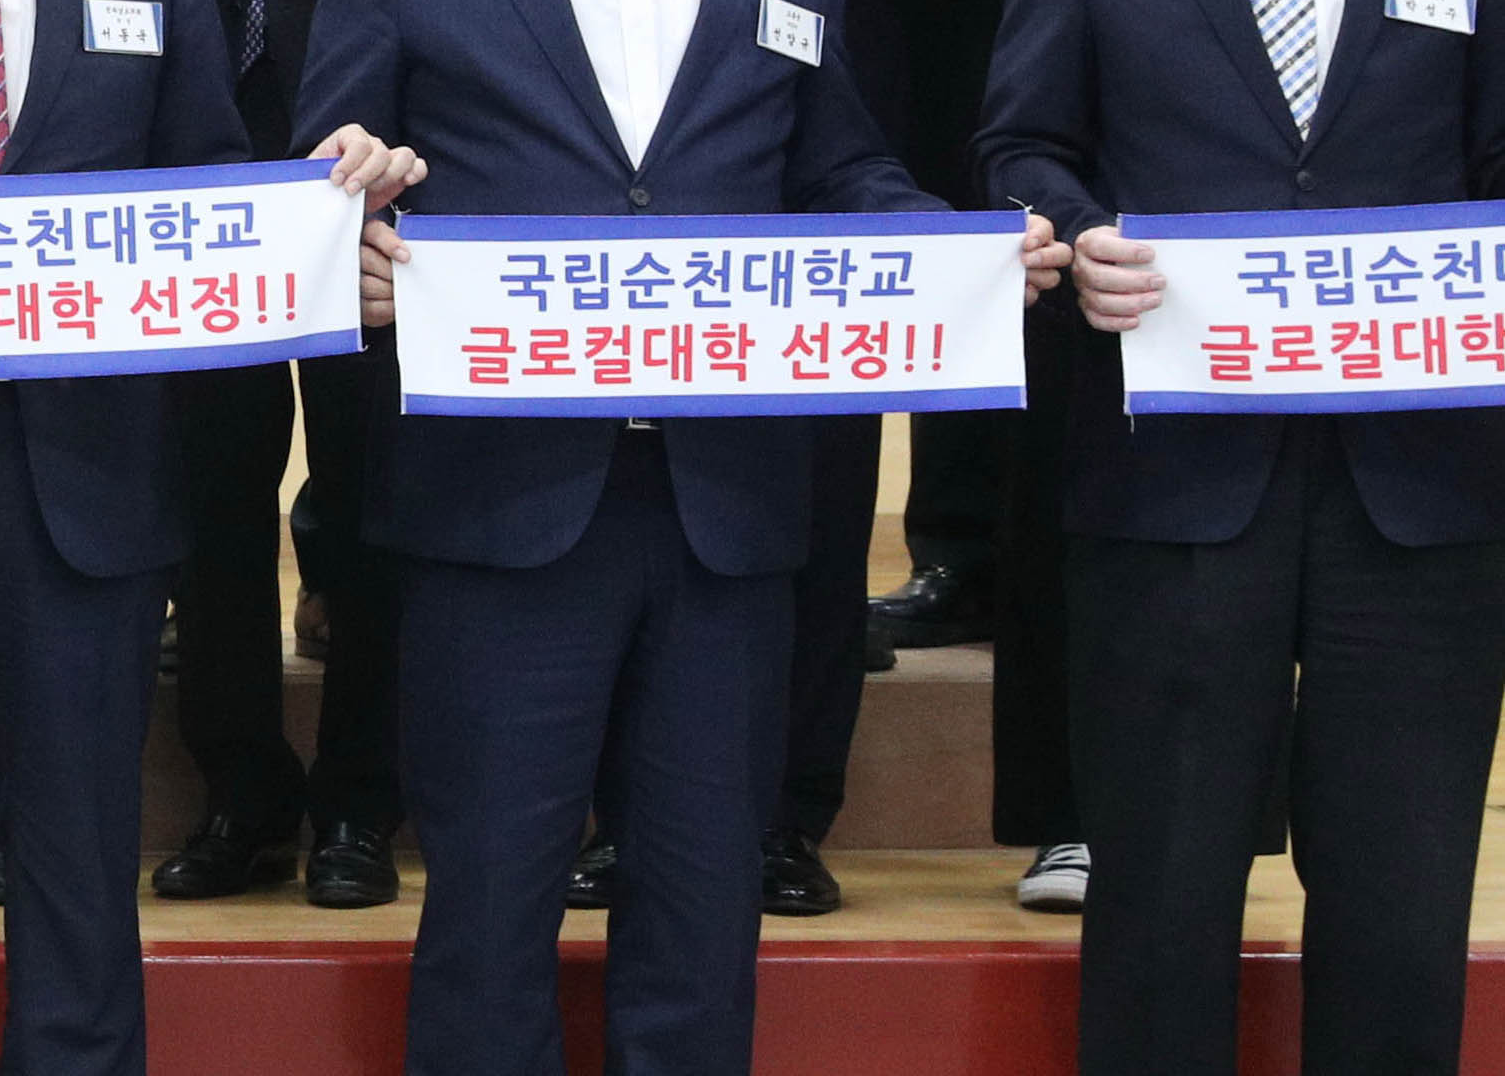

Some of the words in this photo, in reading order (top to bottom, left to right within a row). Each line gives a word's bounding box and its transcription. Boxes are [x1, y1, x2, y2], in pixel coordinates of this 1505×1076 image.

[130, 273, 298, 336] 선정!!
[500, 248, 916, 312] 국립순천대학교
[1238, 240, 1505, 308] 국립순천
[461, 323, 755, 387] 글로컬대학
[781, 321, 945, 382] 선정!!
[1200, 313, 1505, 382] 글로컬대학
